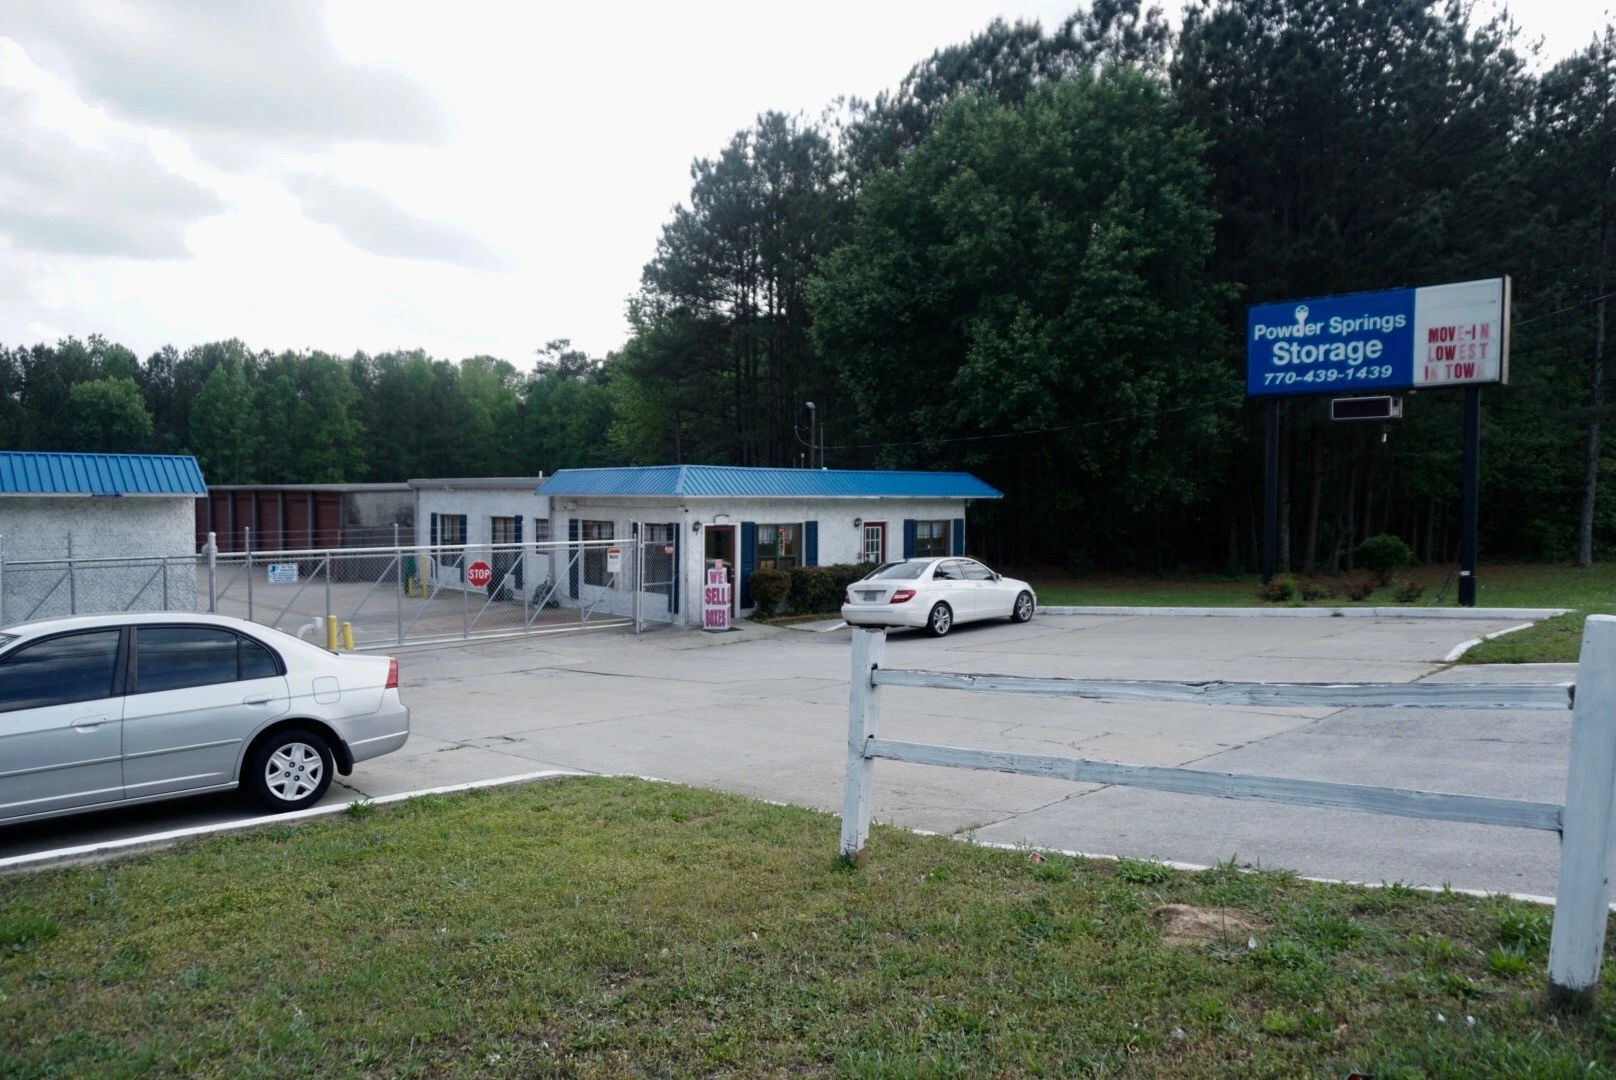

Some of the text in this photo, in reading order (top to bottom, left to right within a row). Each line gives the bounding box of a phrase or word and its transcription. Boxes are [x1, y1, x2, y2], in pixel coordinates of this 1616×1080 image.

[1254, 313, 1406, 341] Powder Springs
[1273, 339, 1383, 366] Storage
[1428, 342, 1488, 362] LOWEST
[1264, 365, 1393, 386] 770-439-1439
[468, 569, 490, 579] STOP
[709, 571, 724, 584] WE
[705, 587, 727, 606] SELL
[705, 608, 726, 627] BOXES
